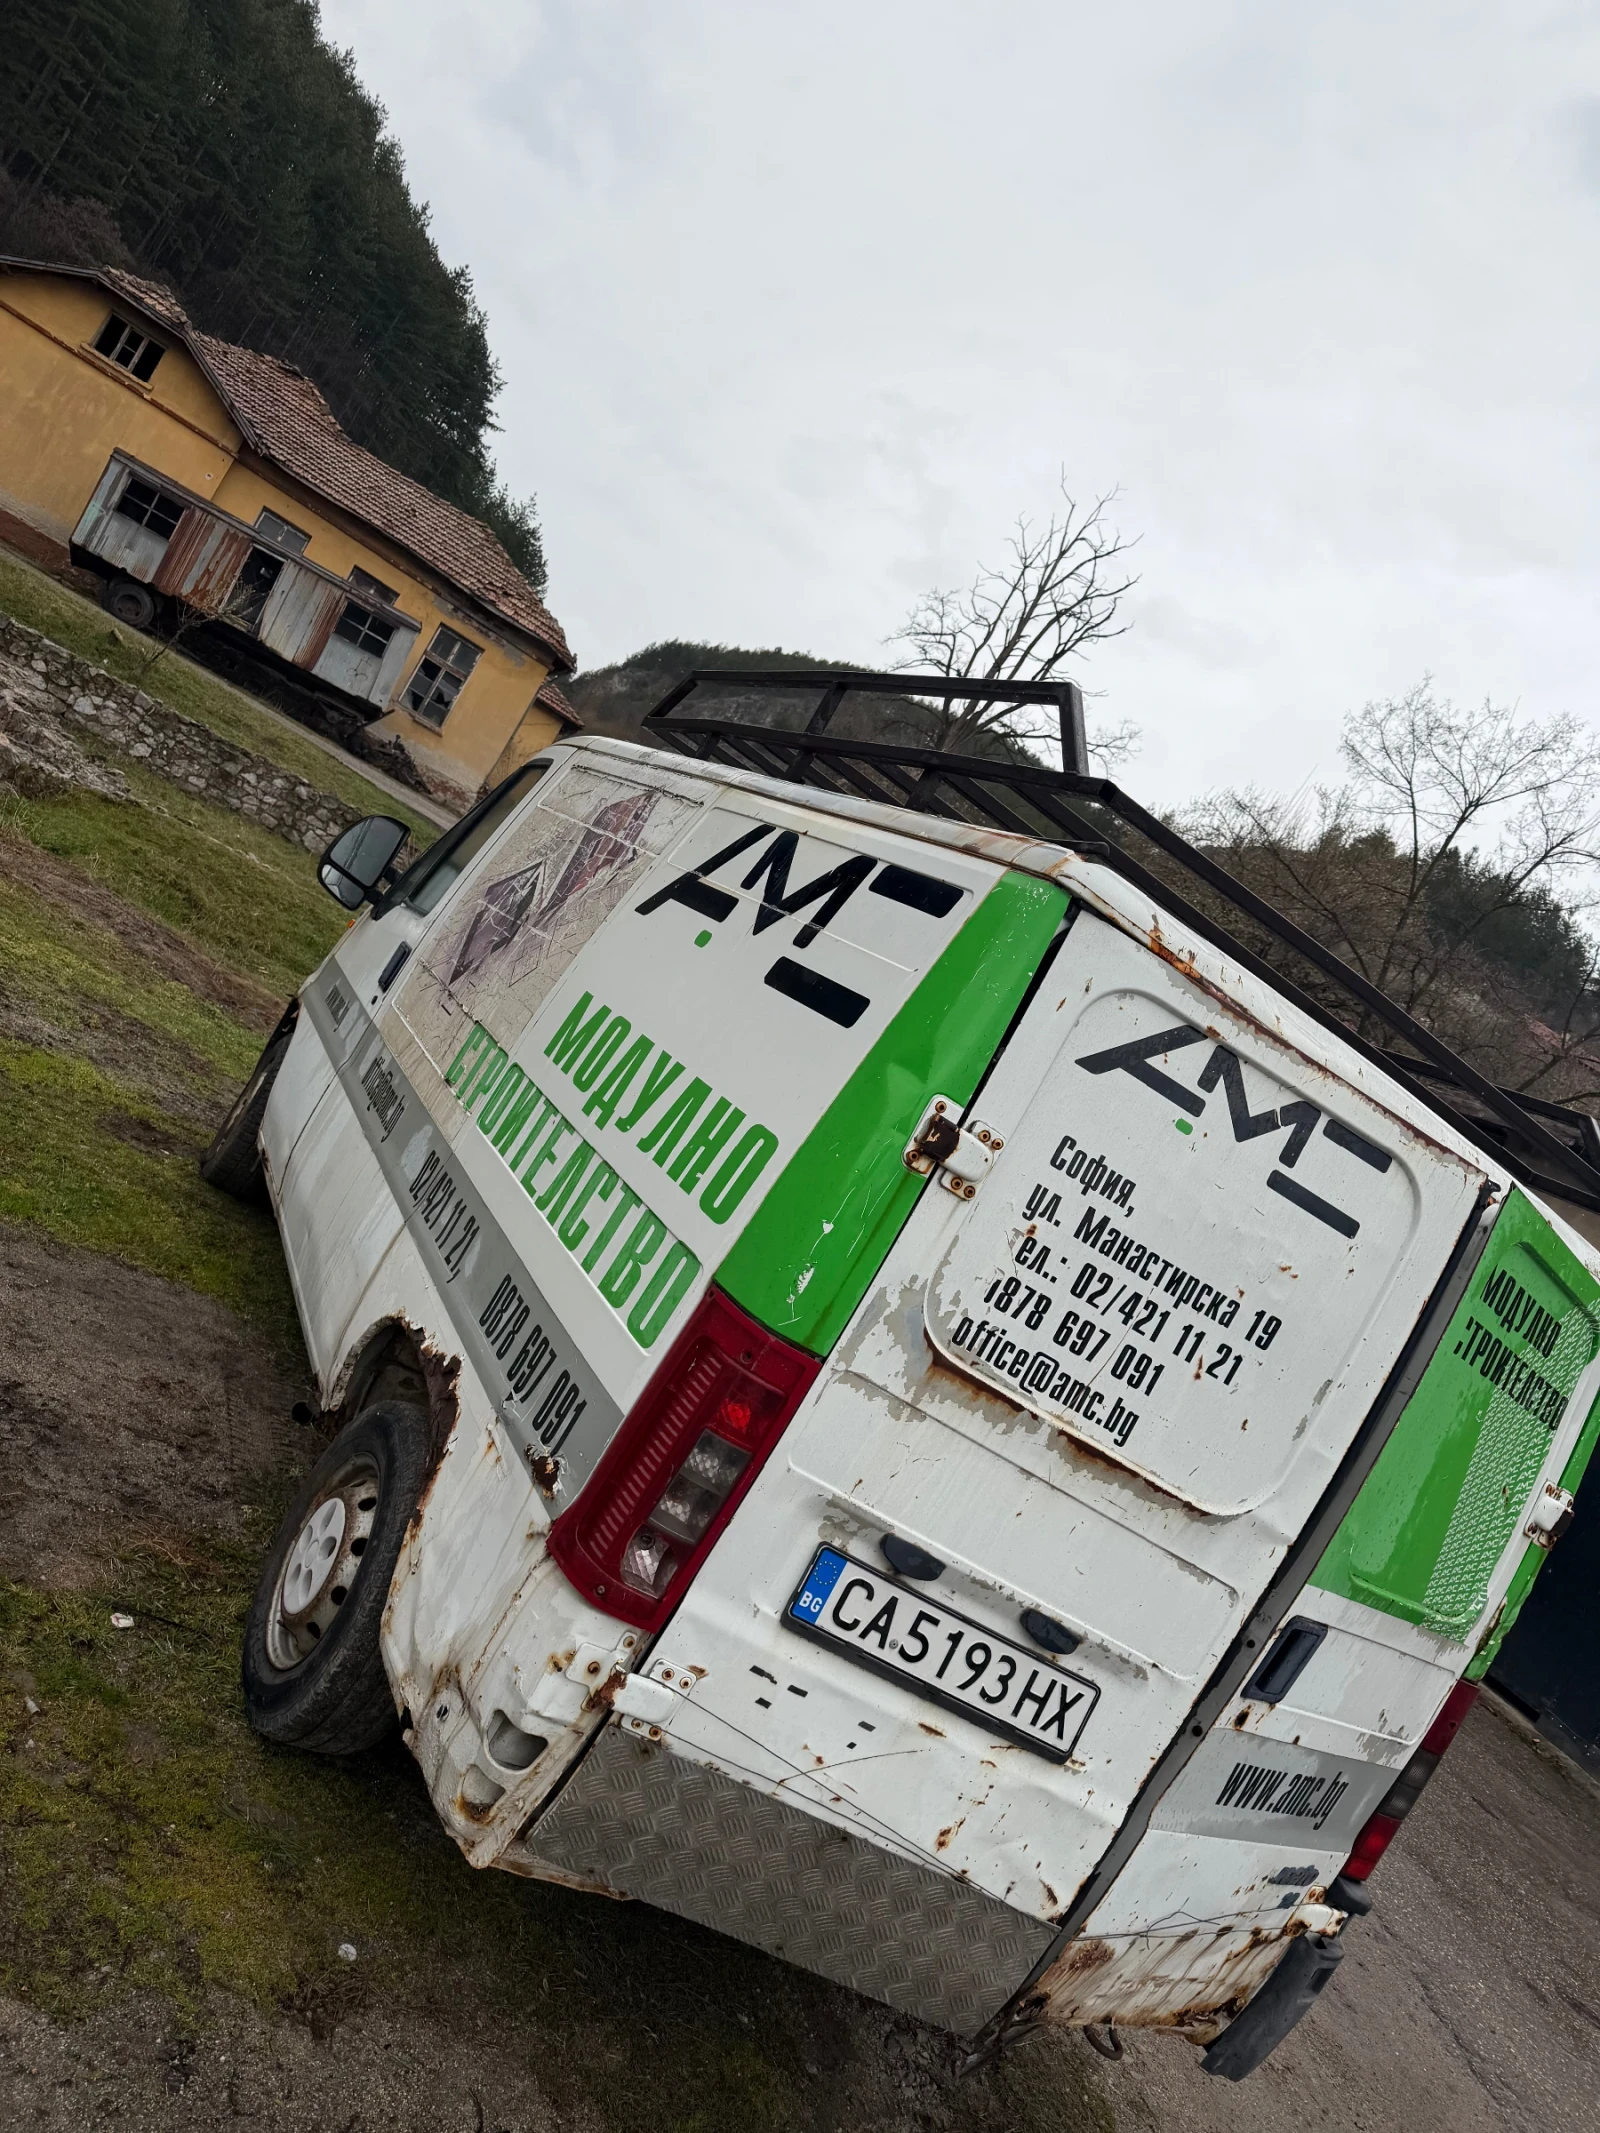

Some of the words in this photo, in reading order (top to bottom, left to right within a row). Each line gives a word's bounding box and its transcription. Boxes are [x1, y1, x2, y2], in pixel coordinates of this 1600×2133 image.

[543, 990, 780, 1225] МОДУЛНО
[445, 1023, 701, 1349] СТРОИТЕЛСТВО
[1049, 1135, 1137, 1218] София,
[435, 1198, 467, 1250] 11
[479, 1273, 530, 1361] 0878
[506, 1324, 557, 1404] 697
[532, 1369, 587, 1457] 091
[1022, 1183, 1062, 1228] ул.
[1073, 1206, 1241, 1329] Манастирска
[1244, 1309, 1283, 1351] 19
[1069, 1262, 1171, 1344] 02/421
[1171, 1324, 1205, 1364] 11
[1206, 1343, 1243, 1386] 21
[1480, 1264, 1562, 1358] МОДУЛНО
[951, 1316, 1140, 1447] office@amc.bg
[1052, 1310, 1111, 1362] 697
[1110, 1344, 1166, 1397] 091
[798, 1590, 823, 1613] BG
